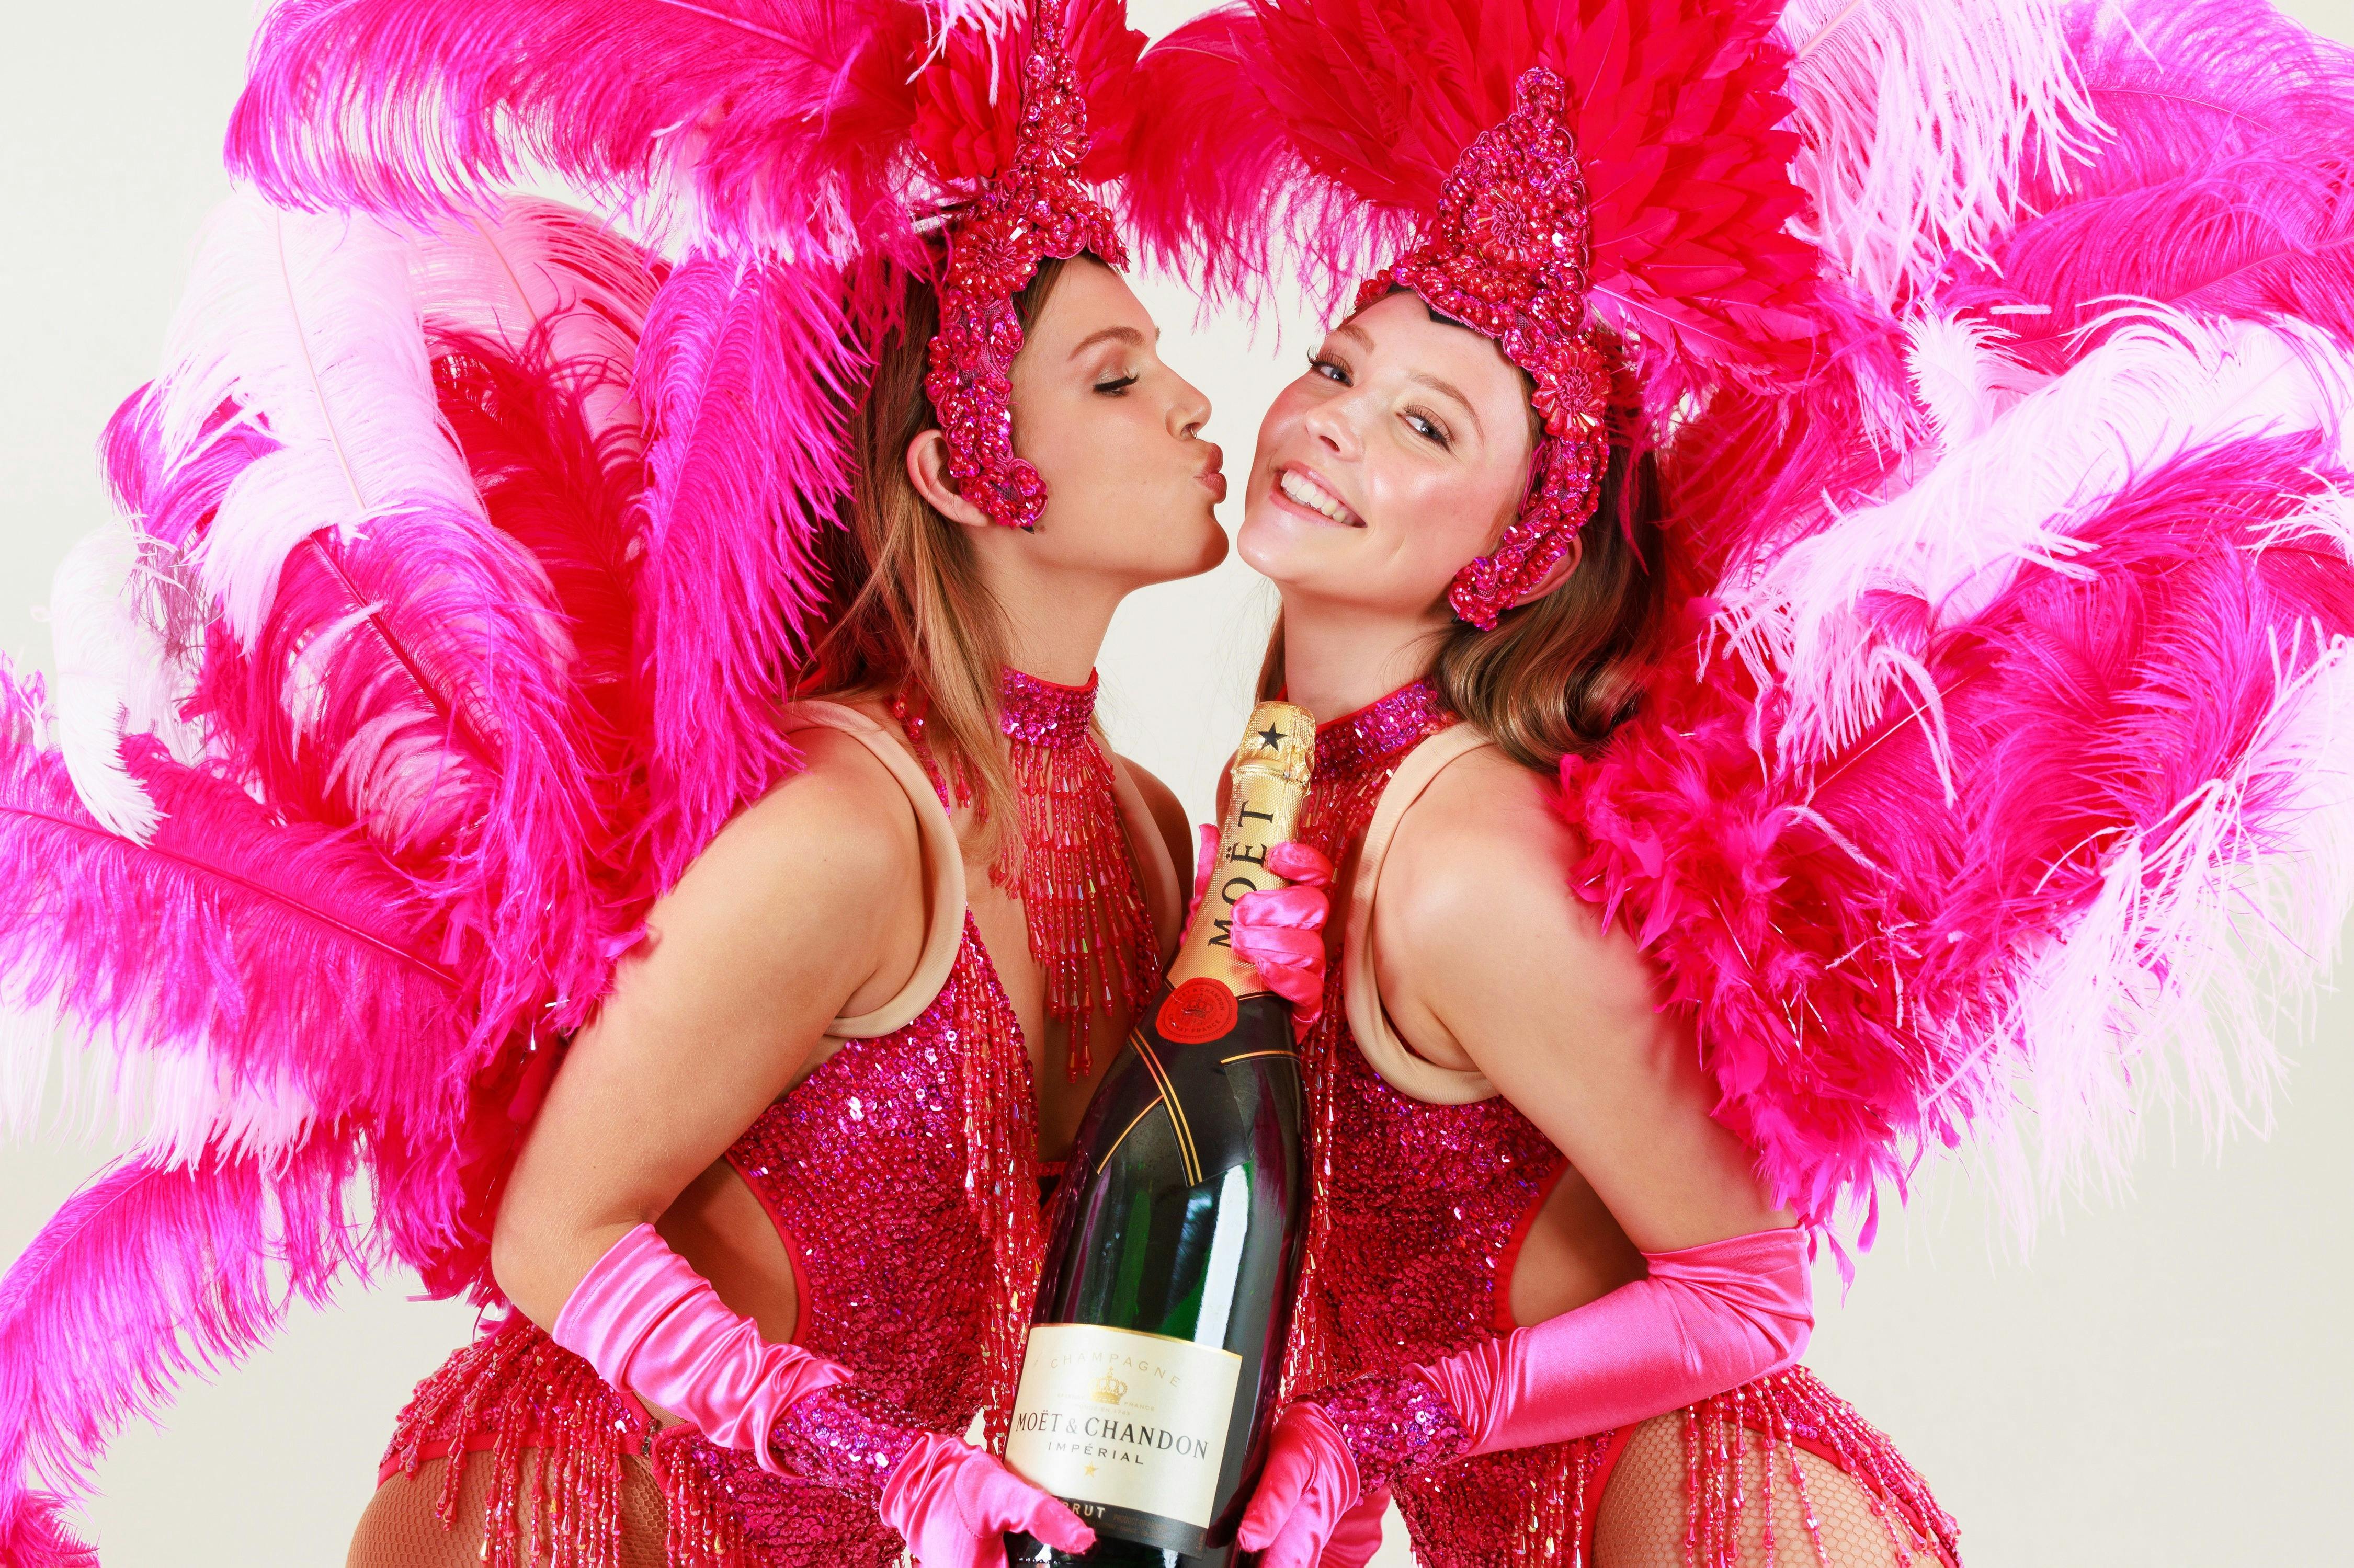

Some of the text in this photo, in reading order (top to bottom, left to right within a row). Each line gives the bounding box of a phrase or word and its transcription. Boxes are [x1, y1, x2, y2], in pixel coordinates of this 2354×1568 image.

[1208, 801, 1274, 948] MOËT
[1200, 988, 1224, 1011] CHANDON
[1191, 1020, 1220, 1033] FRANCE
[1051, 1352, 1180, 1388] CHAMPAGNE
[1124, 1401, 1155, 1412] FRANCE
[1016, 1410, 1209, 1460] MOËT & CHANDON
[1048, 1441, 1144, 1464] IMPÉRIAL
